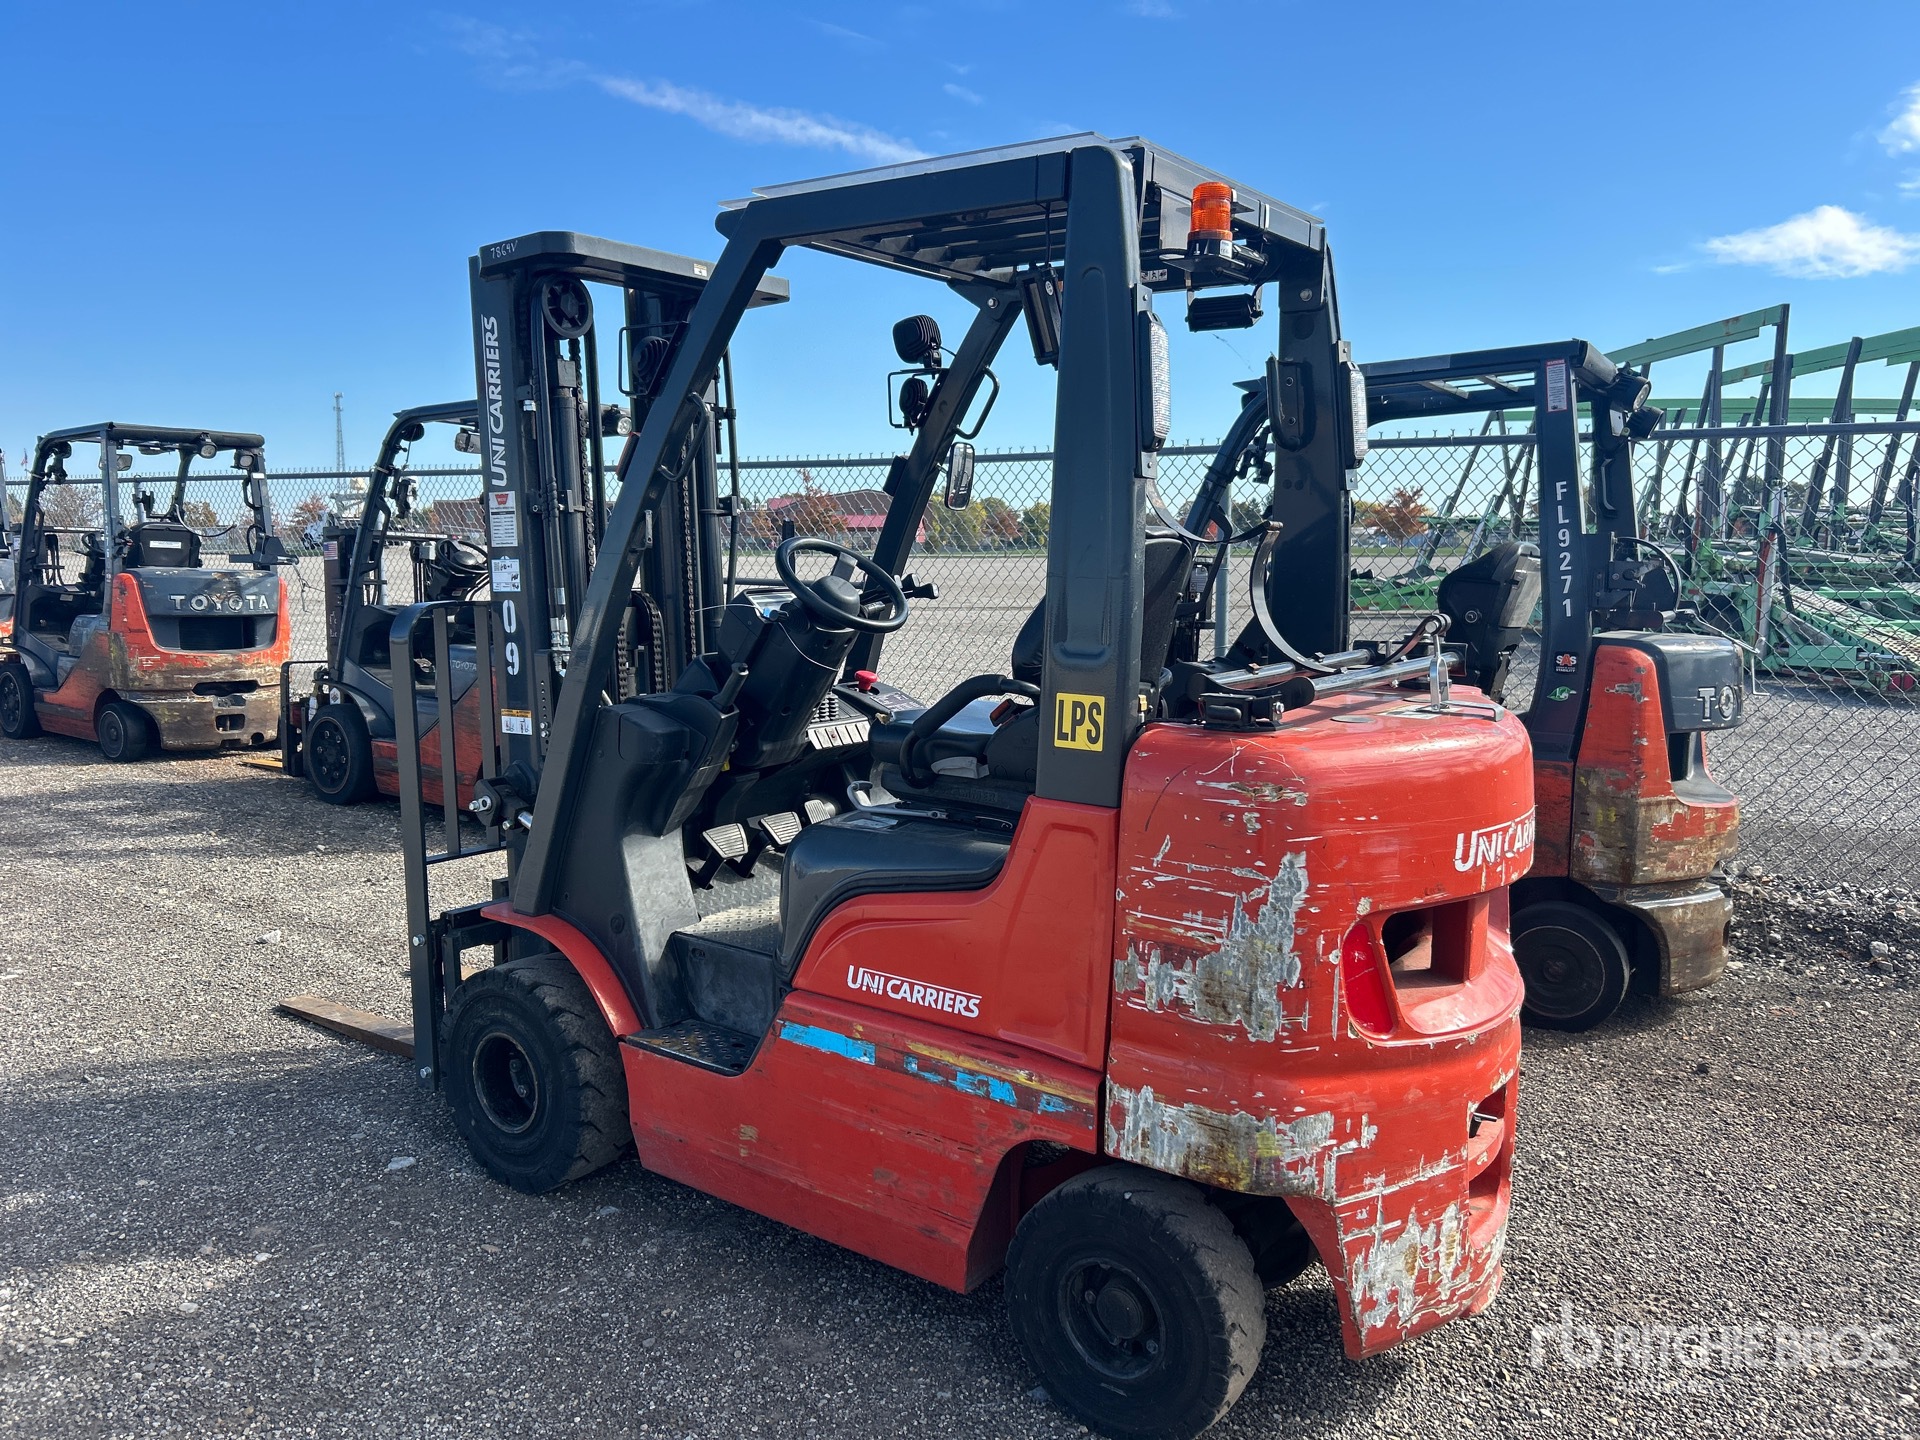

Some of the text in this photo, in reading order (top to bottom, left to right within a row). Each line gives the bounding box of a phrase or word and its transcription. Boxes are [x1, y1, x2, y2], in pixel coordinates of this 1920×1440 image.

[1555, 481, 1572, 617] FL9271
[169, 593, 271, 611] TOYOTA
[452, 660, 477, 671] TOYOTA
[1556, 654, 1577, 666] SAS
[1697, 685, 1741, 722] TO
[1056, 699, 1102, 744] LPS
